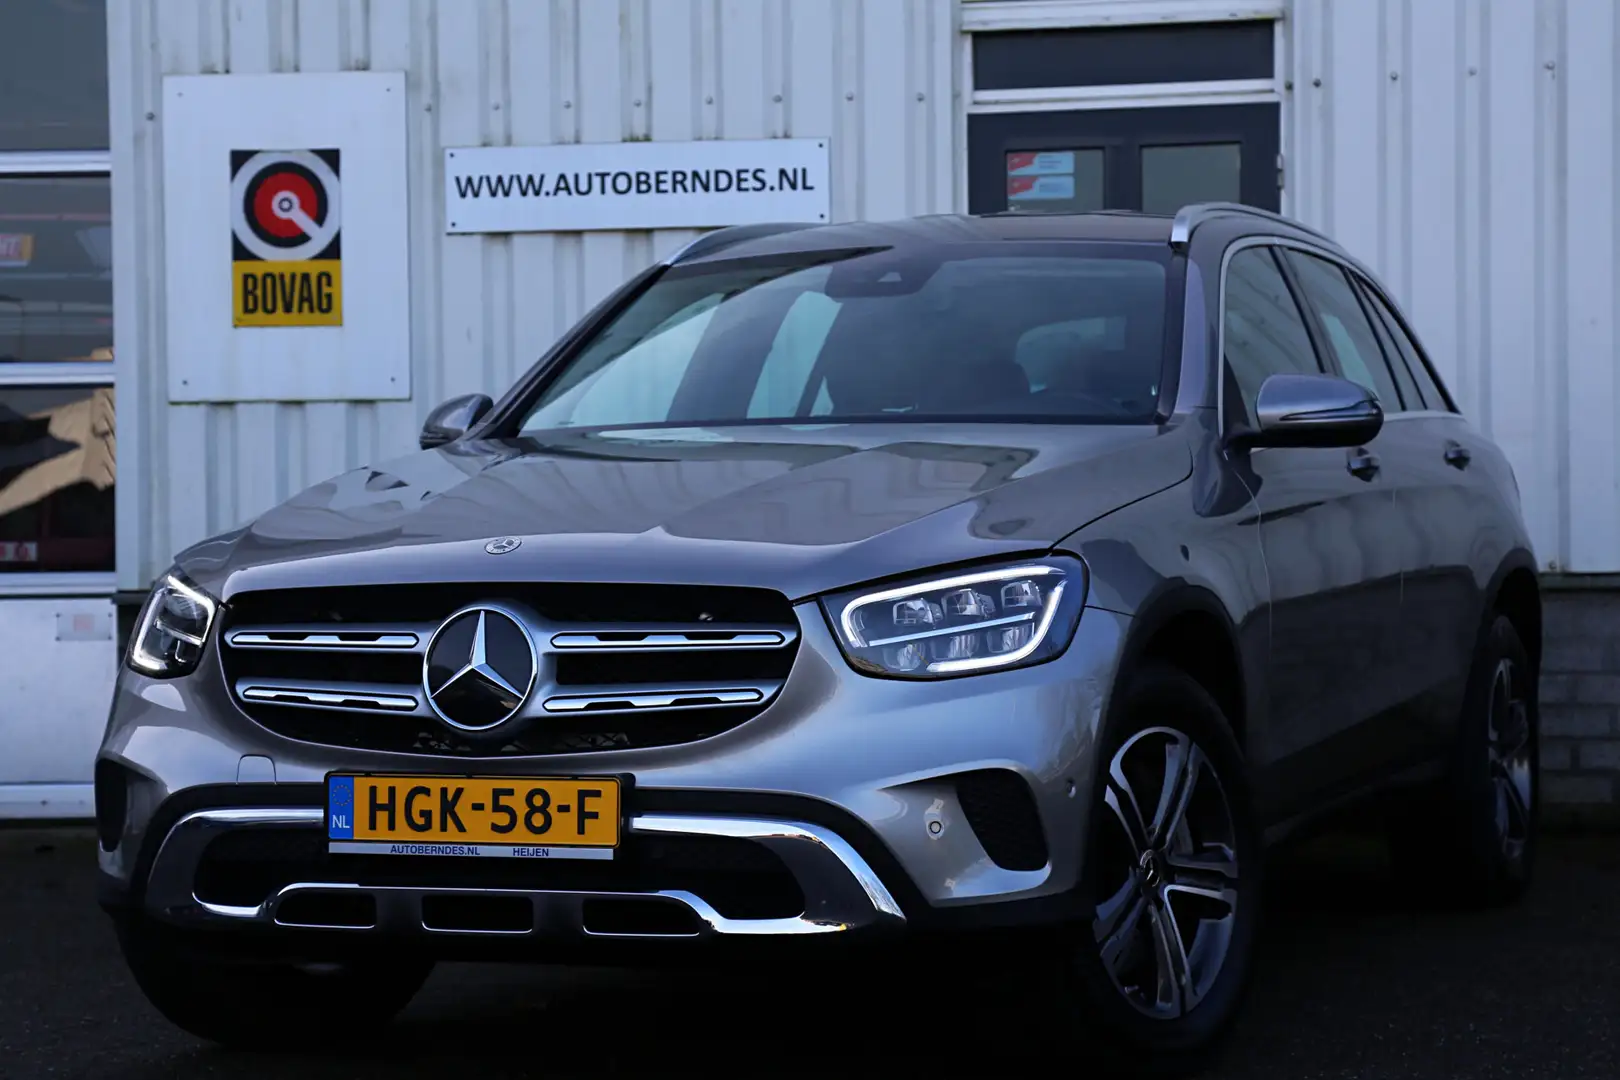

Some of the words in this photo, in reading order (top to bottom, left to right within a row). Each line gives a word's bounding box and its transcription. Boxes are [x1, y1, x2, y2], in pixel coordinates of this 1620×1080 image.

[455, 167, 814, 199] WWW.AUTOBERNDES.NL
[242, 271, 333, 314] BOVAG
[332, 814, 350, 829] NL
[368, 785, 602, 836] HGK-58-F
[390, 845, 480, 856] AUTOBERNDES.NL
[512, 847, 549, 858] HEIJEN
